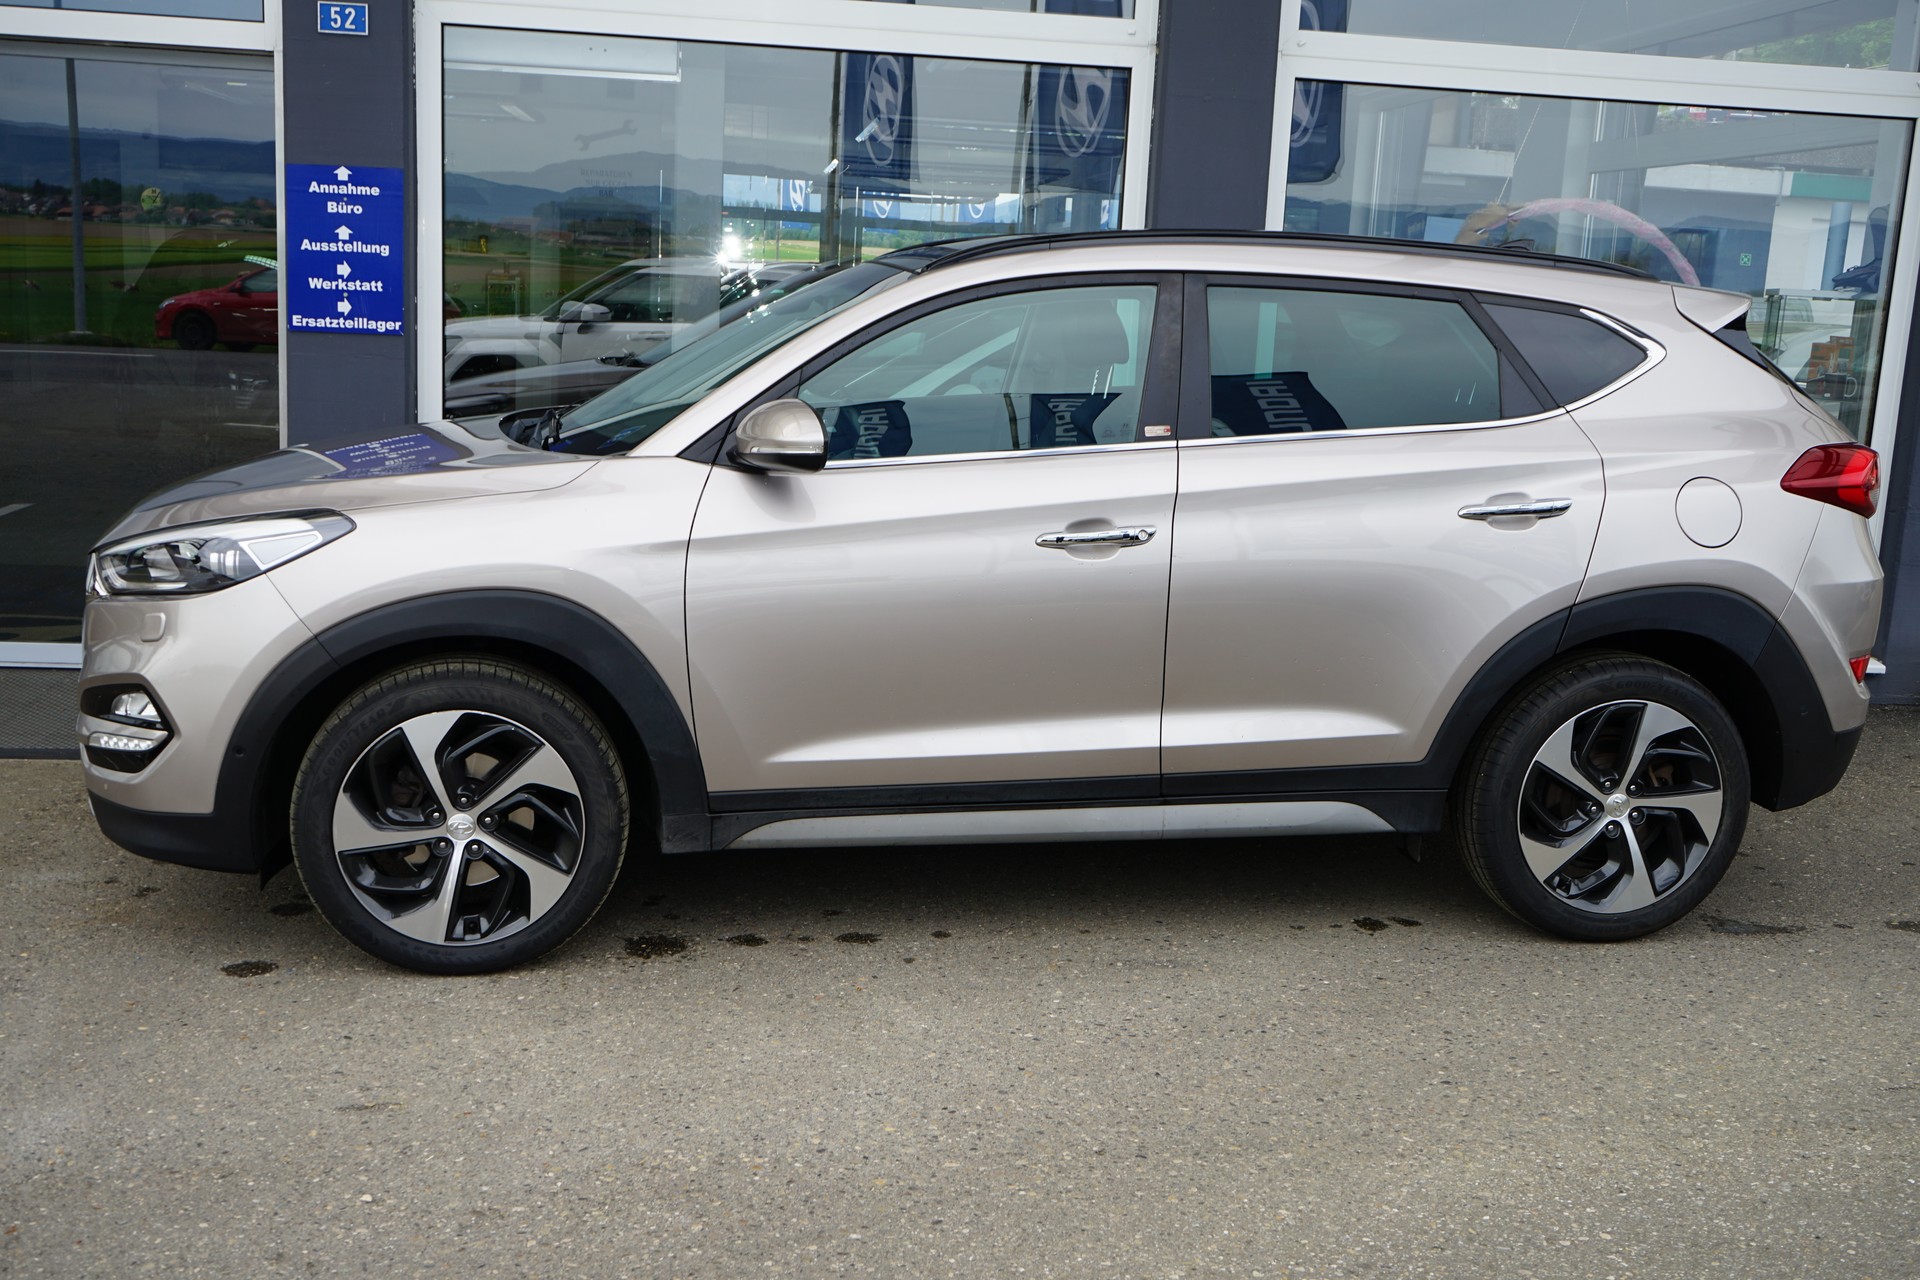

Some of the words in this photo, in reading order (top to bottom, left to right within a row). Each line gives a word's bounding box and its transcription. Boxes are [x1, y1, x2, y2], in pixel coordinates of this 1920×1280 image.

[330, 6, 356, 30] 52
[308, 181, 380, 196] Annahme
[327, 201, 363, 214] Büro
[300, 239, 390, 257] Ausstellung
[308, 277, 384, 292] Werkstatt
[292, 314, 402, 332] Ersatzteillager
[322, 708, 386, 776] GOODYEAR
